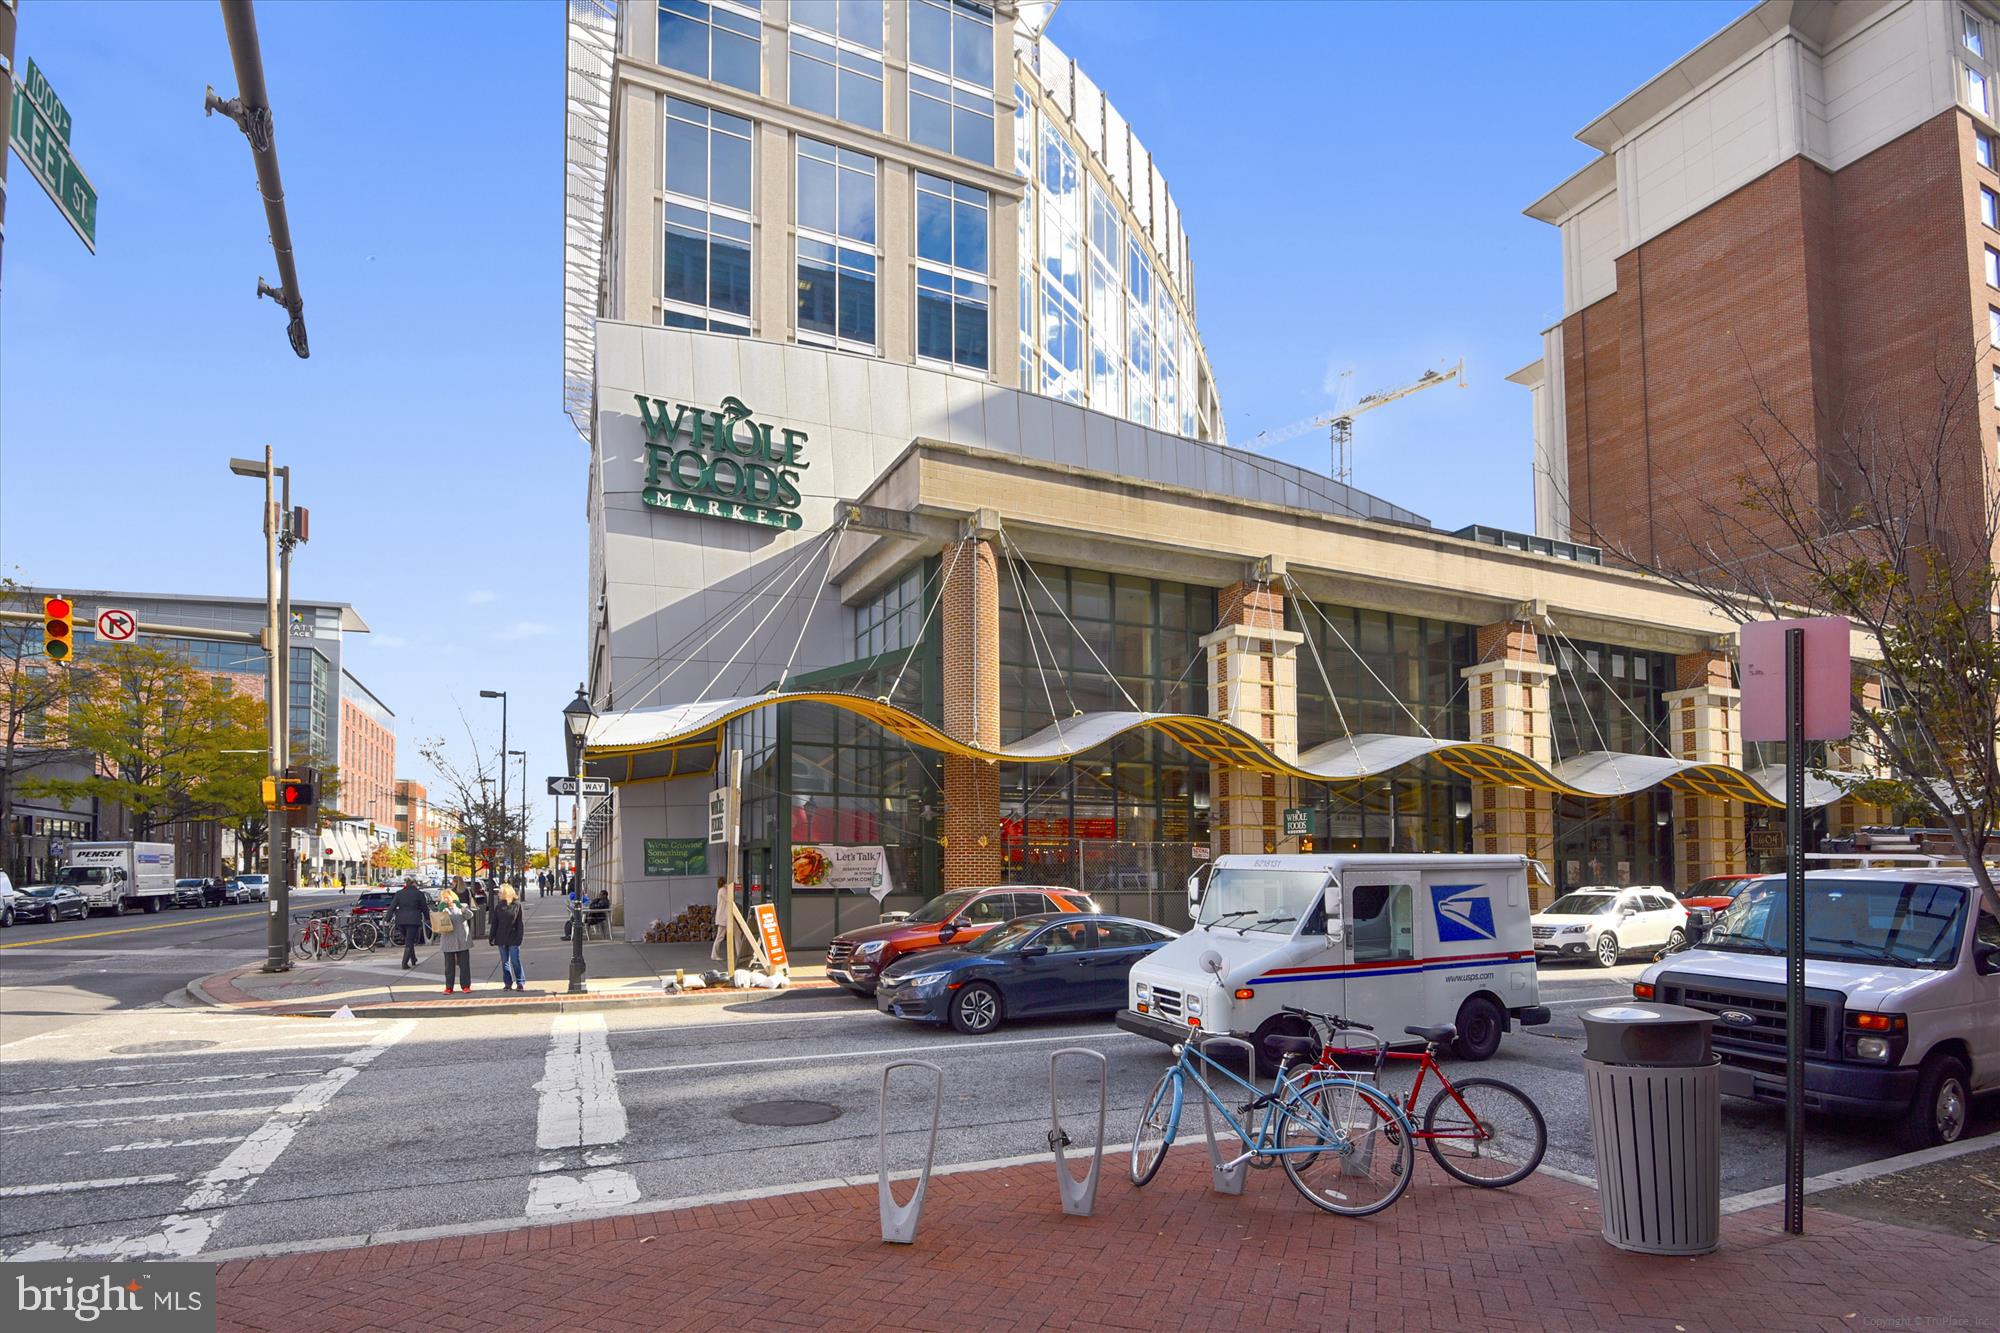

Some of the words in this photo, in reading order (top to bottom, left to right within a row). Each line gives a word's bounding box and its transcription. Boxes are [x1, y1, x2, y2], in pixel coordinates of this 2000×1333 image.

[33, 66, 62, 128] 1000
[634, 394, 811, 470] WHOLE
[643, 442, 802, 510] FOODS
[655, 491, 793, 529] MARKET
[289, 624, 314, 632] YATT
[562, 782, 576, 791] ON
[585, 783, 604, 792] WAY
[1286, 812, 1308, 821] WHOLE
[1287, 821, 1307, 830] FOODS
[670, 840, 703, 850] Growing
[76, 849, 125, 858] PENSKE
[647, 849, 689, 857] Something
[836, 852, 856, 862] Let's
[856, 852, 875, 862] Talk
[647, 857, 670, 865] Good
[1445, 972, 1495, 983] www.usps.com
